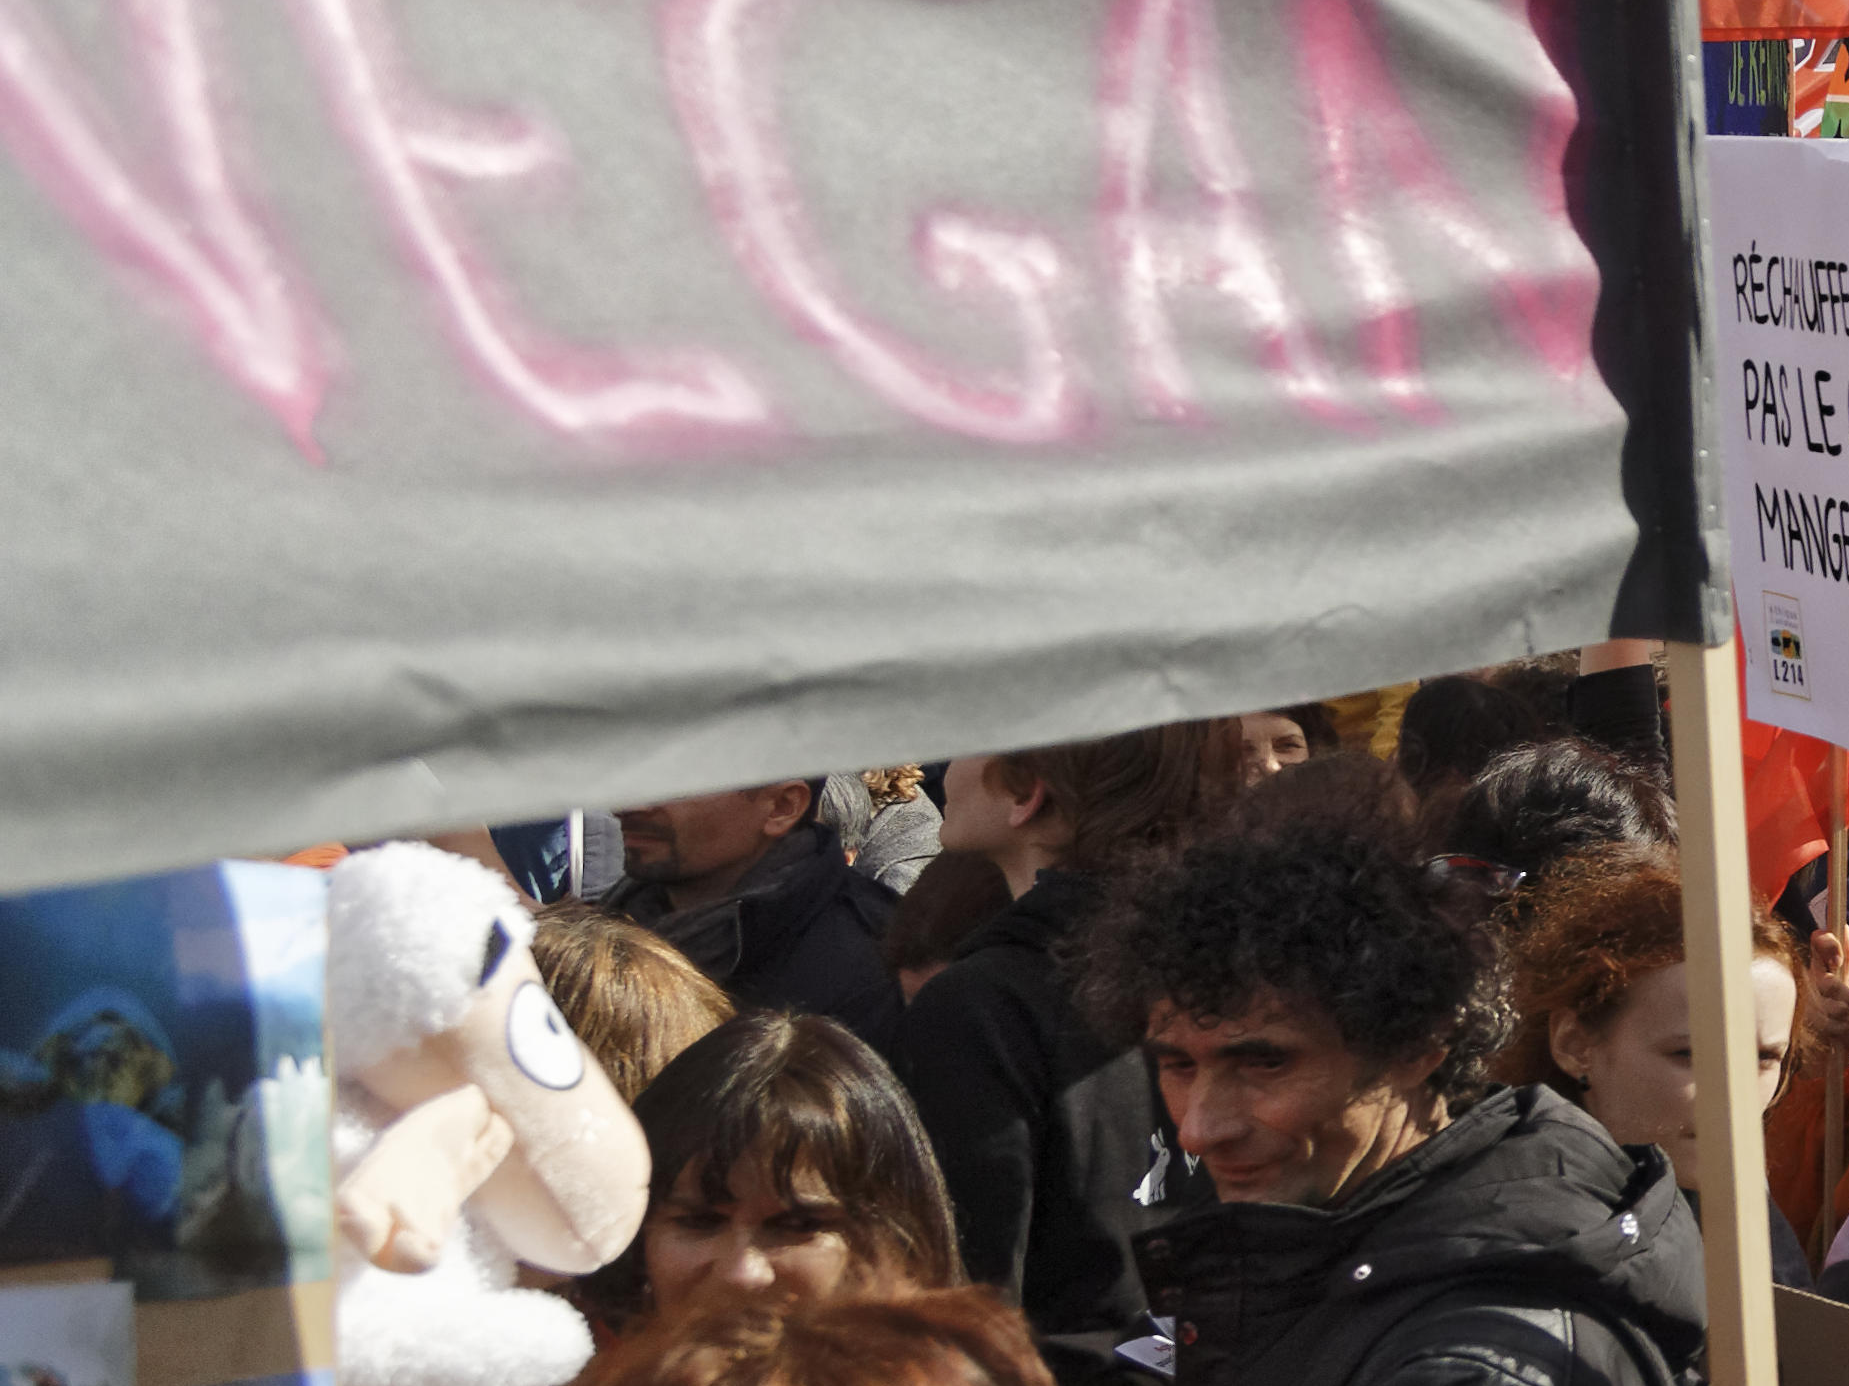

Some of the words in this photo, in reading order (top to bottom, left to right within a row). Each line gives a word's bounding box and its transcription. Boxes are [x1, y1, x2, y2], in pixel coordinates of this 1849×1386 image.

[1743, 358, 1793, 448] PAS
[1798, 365, 1843, 457] LE
[1773, 659, 1805, 686] L214
